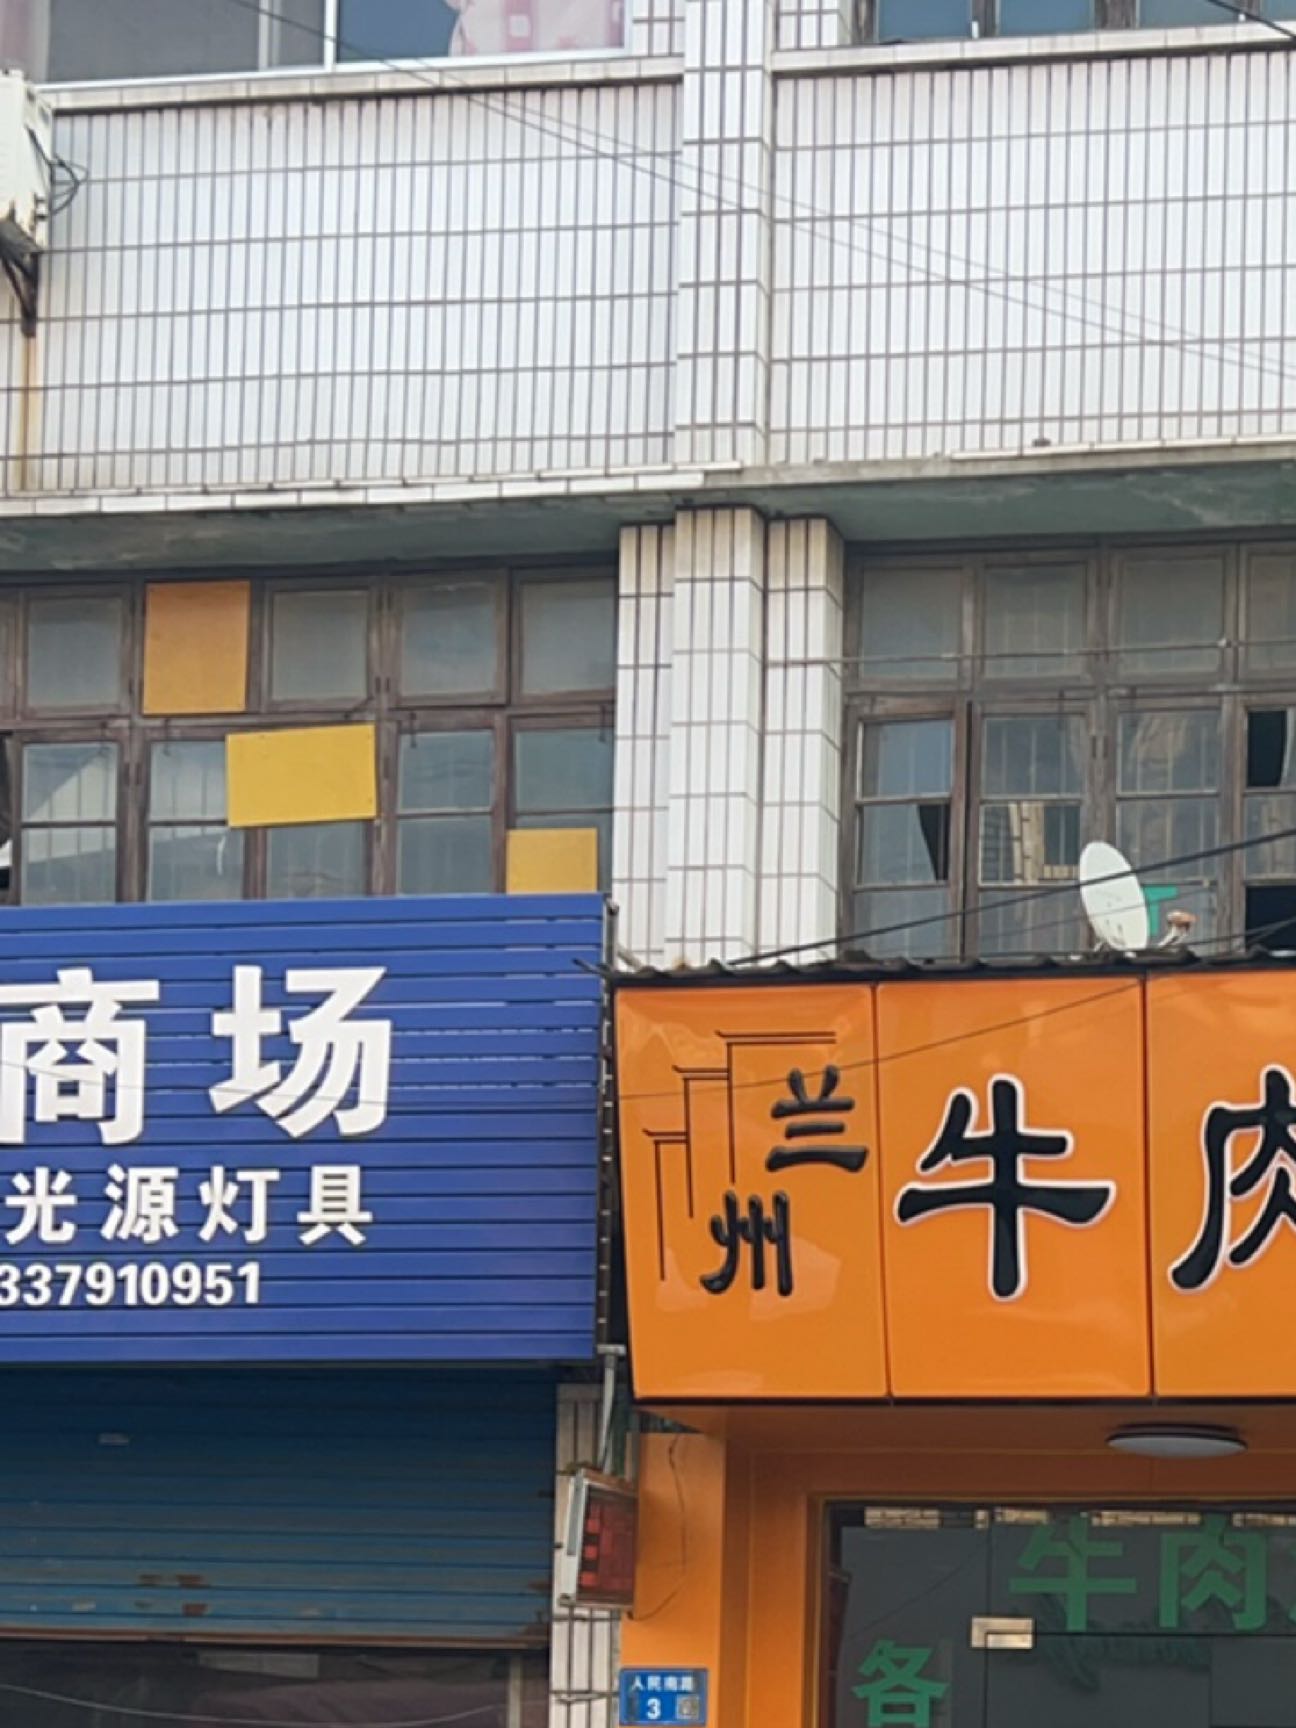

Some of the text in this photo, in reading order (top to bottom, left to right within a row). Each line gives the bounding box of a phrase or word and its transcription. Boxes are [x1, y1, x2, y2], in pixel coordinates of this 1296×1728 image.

[0, 966, 391, 1144] 商场
[6, 1164, 373, 1245] 光源灯具
[700, 1064, 869, 1297] 兰州
[647, 1698, 661, 1720] 3
